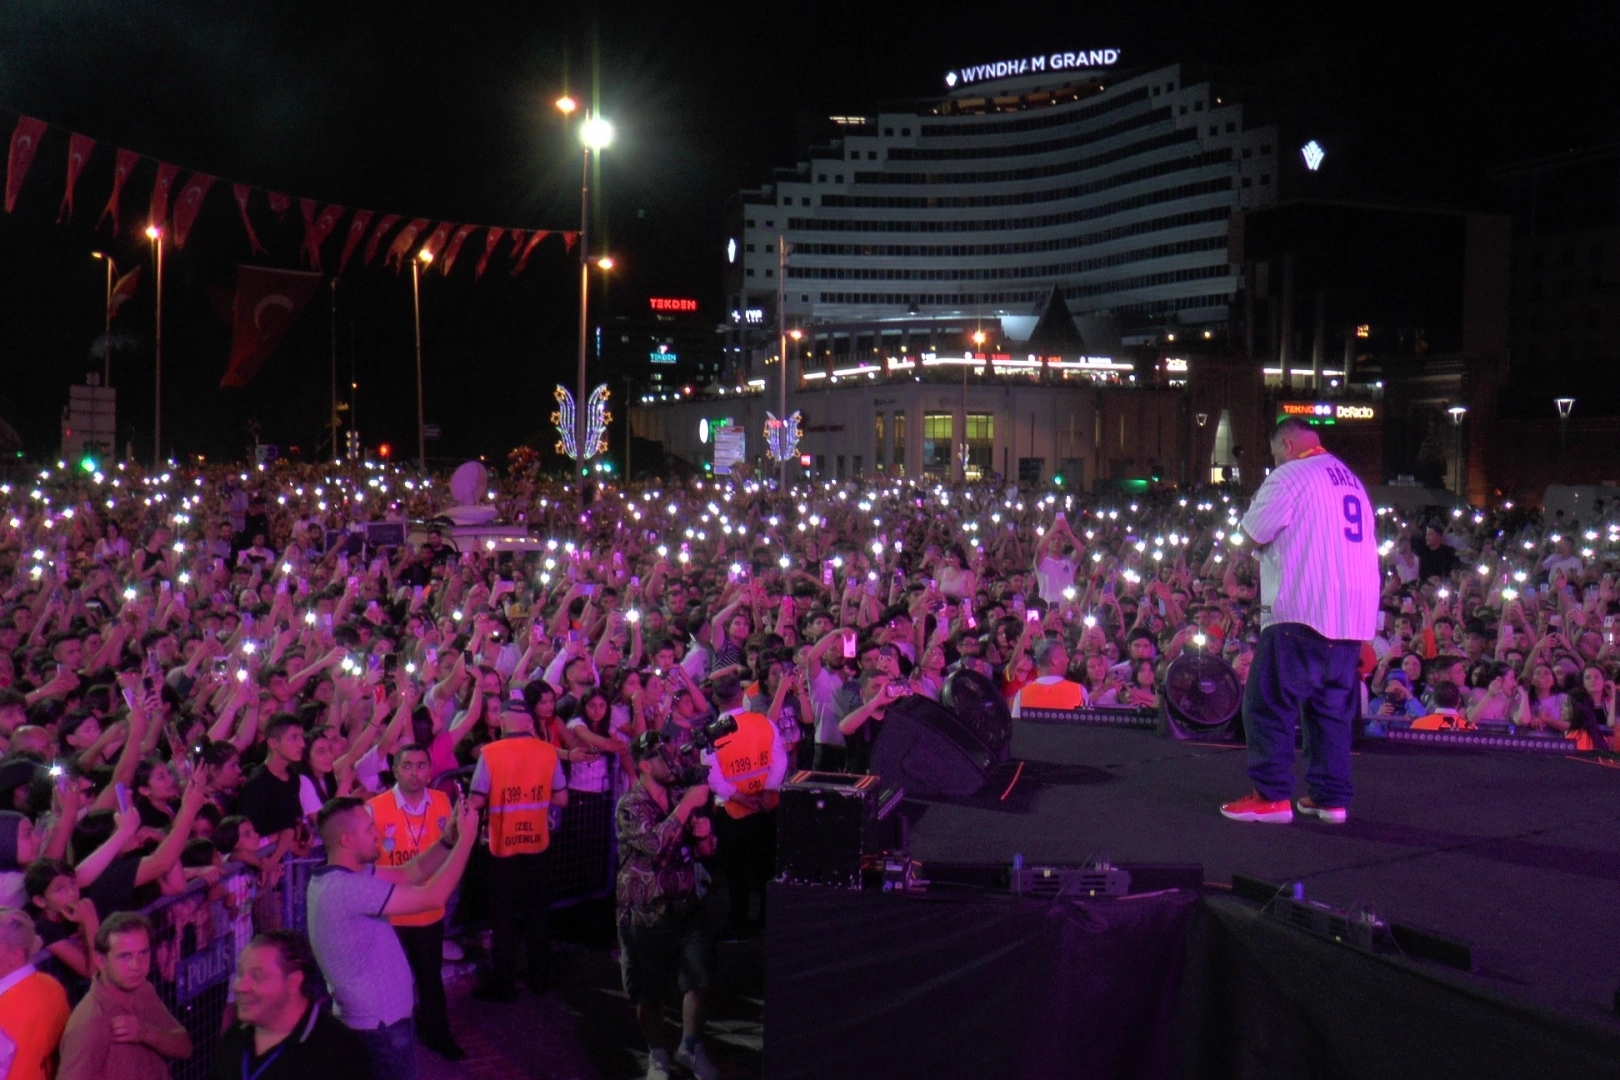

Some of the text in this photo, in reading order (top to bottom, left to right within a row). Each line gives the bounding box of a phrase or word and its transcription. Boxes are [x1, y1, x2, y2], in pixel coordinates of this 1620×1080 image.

[961, 49, 1119, 83] WYNDHAM GRAND
[650, 298, 696, 310] TEKDEN
[1343, 494, 1363, 542] 9
[729, 756, 752, 774] 1399
